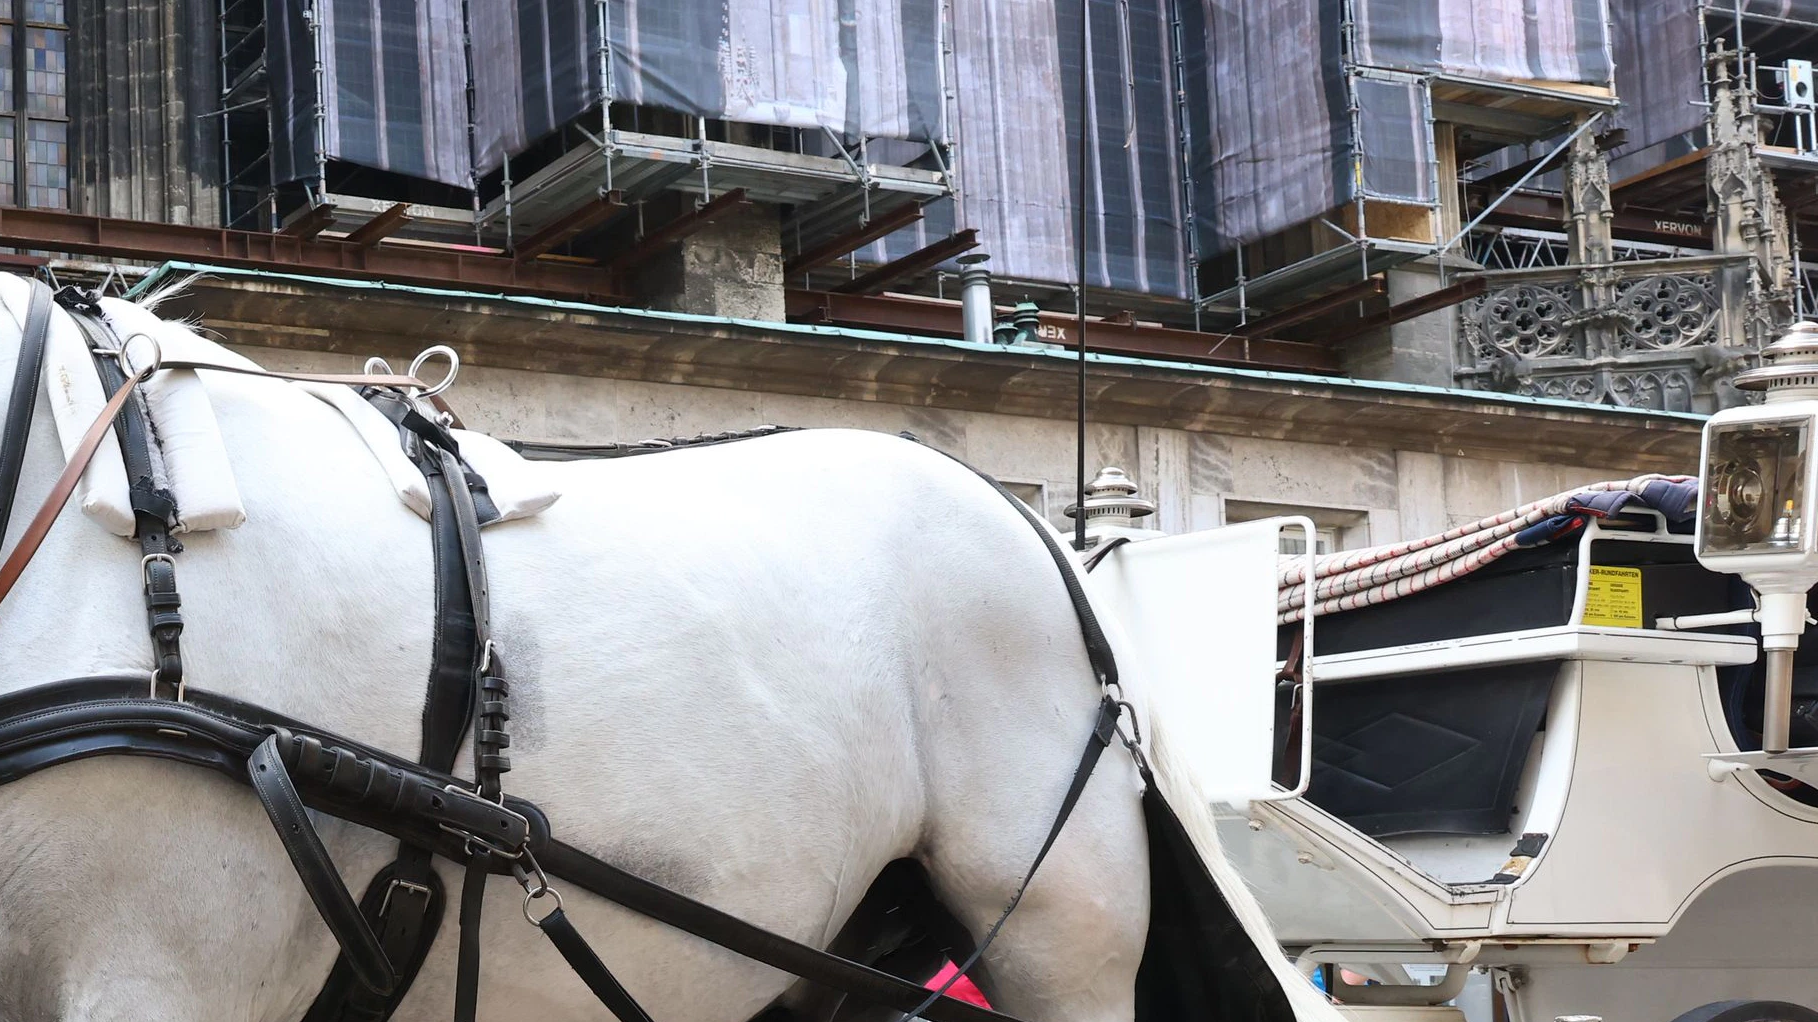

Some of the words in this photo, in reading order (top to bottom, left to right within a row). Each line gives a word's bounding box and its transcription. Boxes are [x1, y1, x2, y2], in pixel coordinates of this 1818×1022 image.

[1654, 220, 1702, 236] XERVON
[1034, 324, 1066, 340] XER
[1589, 568, 1639, 578] KER-RUNDFAHRTEN
